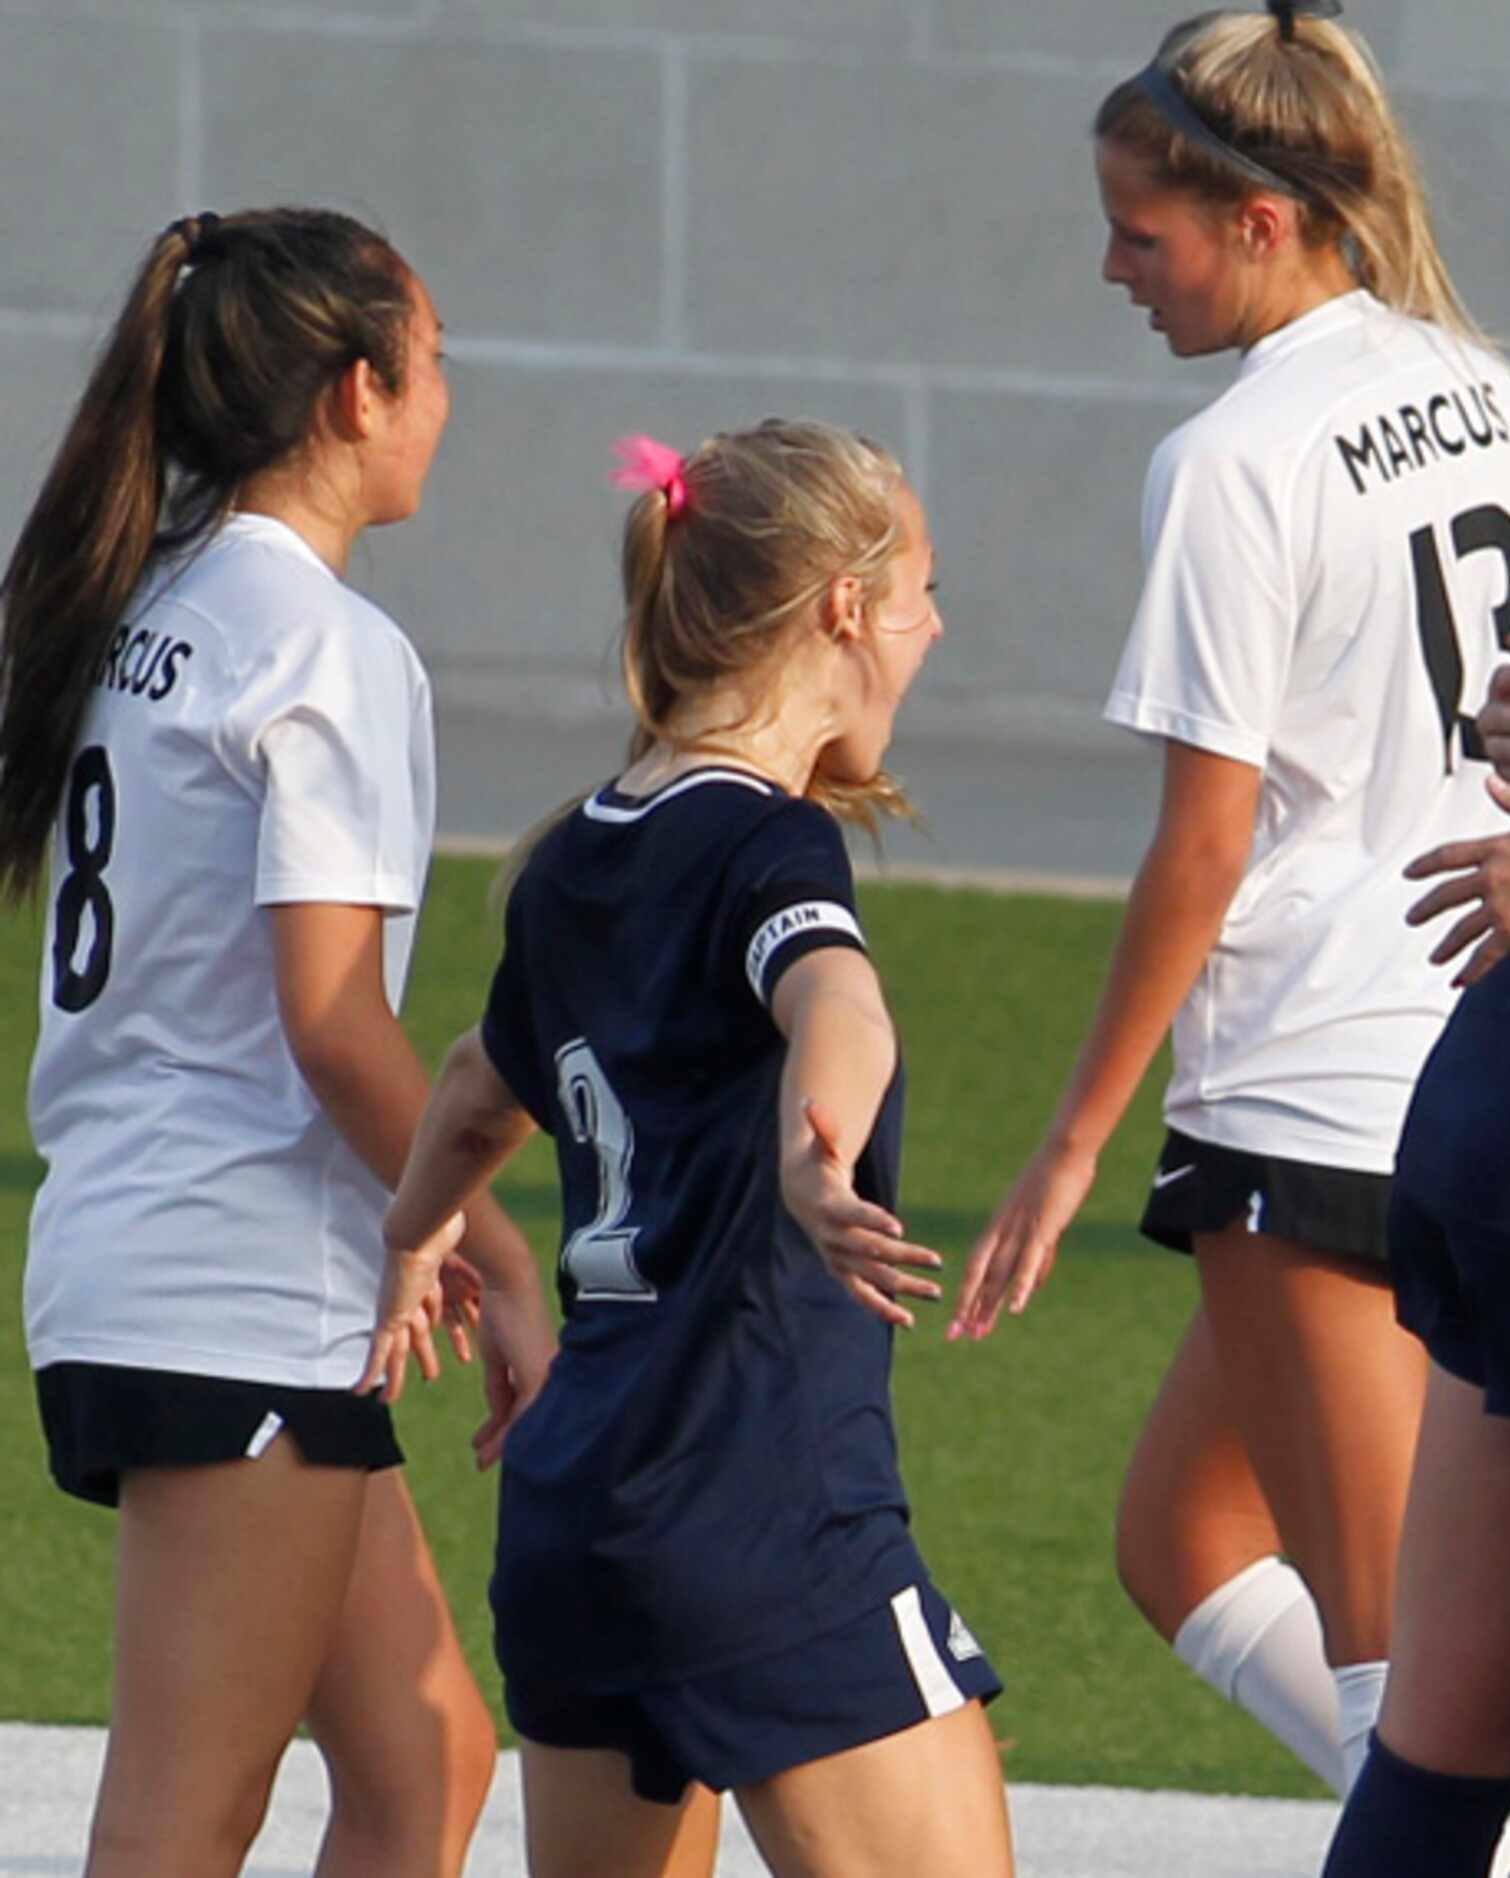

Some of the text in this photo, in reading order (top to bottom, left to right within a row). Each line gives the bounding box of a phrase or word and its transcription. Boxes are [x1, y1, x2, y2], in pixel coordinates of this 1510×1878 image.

[1334, 382, 1510, 494] MARCUS
[97, 625, 193, 701] RCUS
[52, 745, 115, 1013] 8
[554, 1036, 658, 1302] 2
